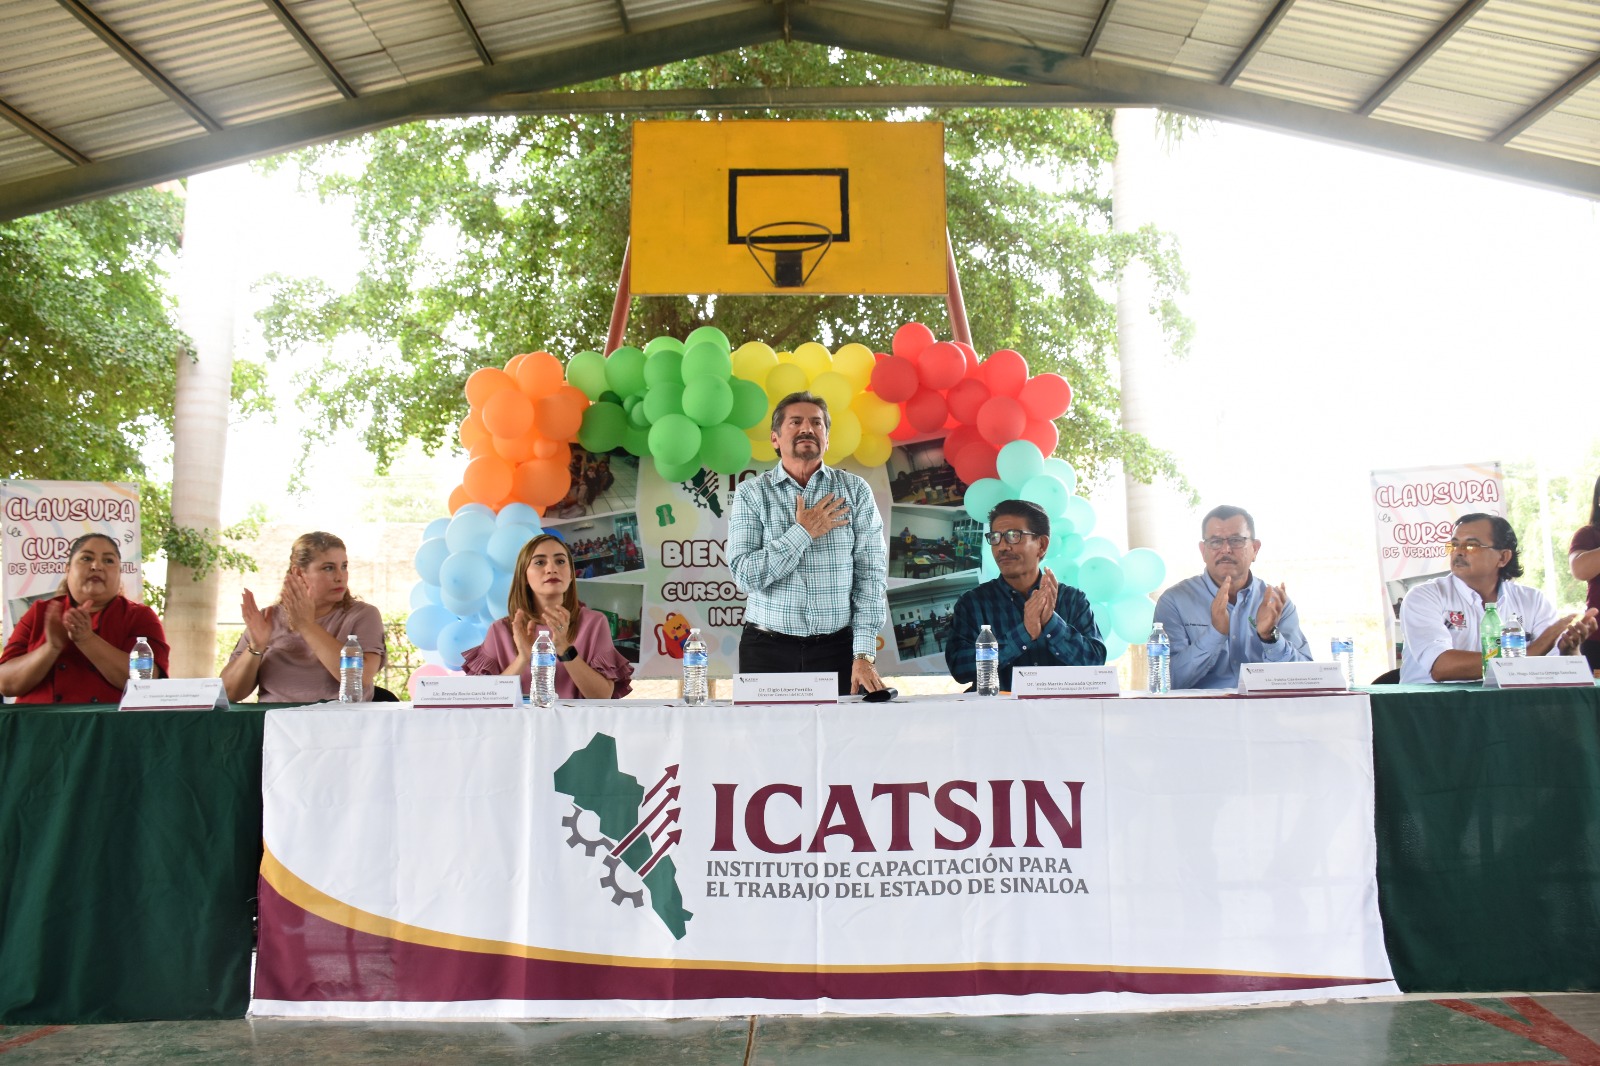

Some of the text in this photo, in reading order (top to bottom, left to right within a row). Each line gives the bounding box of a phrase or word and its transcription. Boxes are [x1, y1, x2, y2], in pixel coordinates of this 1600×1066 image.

[1375, 479, 1499, 508] CLAUSURA
[5, 497, 136, 522] CLAUSURA
[1393, 521, 1456, 545] CURS
[1382, 547, 1400, 559] DE
[8, 562, 28, 575] DE
[709, 779, 1085, 854] ICATSIN
[706, 853, 1073, 878] INSTITUTO DE CAPACITACIÓN PARA
[706, 877, 1090, 901] EL TRABAJO DEL ESTADO DE SINALOA
